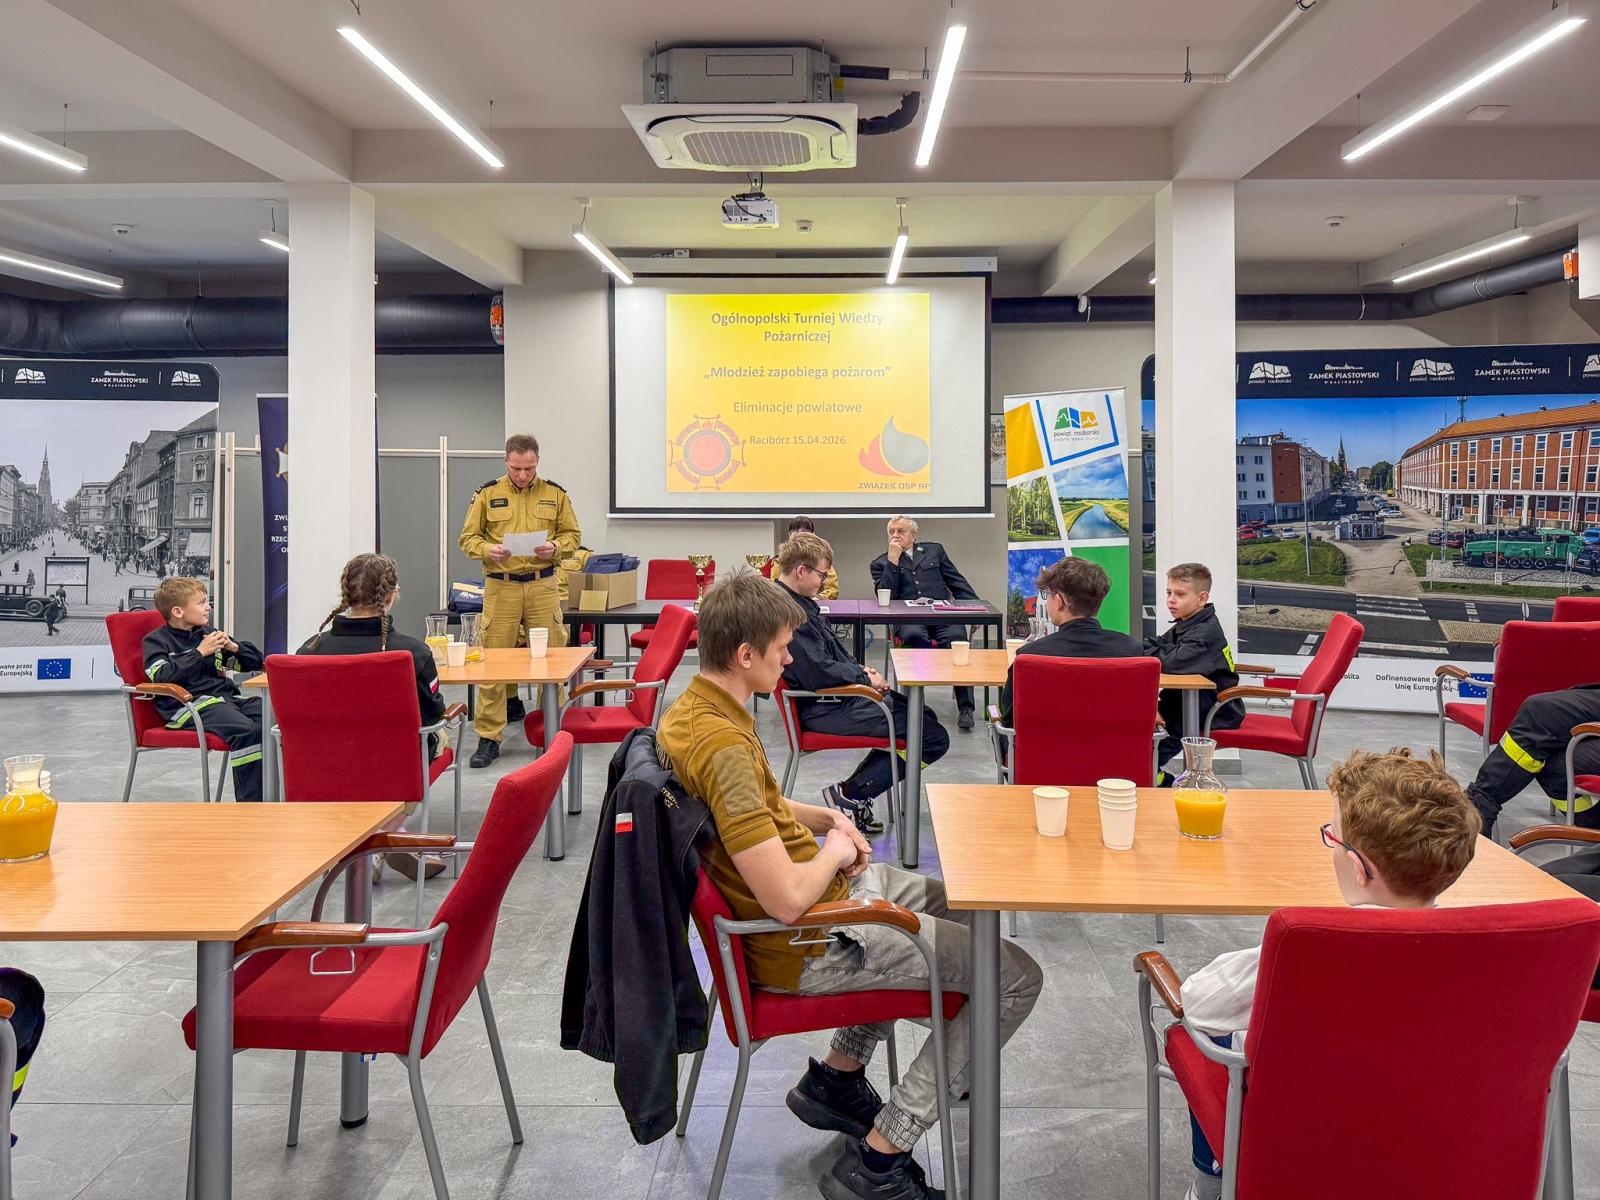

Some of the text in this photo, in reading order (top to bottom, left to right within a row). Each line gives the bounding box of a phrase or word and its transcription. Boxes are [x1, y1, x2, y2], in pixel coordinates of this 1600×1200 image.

[711, 312, 883, 326] Ogólnopolski Turniej Wiedzy
[764, 330, 831, 343] Pożarniczej
[704, 365, 764, 379] „Młodzież
[768, 365, 828, 379] zapobiega
[1308, 371, 1380, 380] ZAMEK PIASTOWSKI
[1503, 367, 1550, 375] PIASTOWSKI
[733, 401, 862, 414] Eliminacje powiatowe
[749, 435, 846, 445] Racibórz 15.04.2026
[858, 482, 930, 491] ZWIĄZEK OSP RP
[16, 663, 33, 671] przez
[1375, 673, 1430, 683] Dofinansowane
[1394, 683, 1411, 691] Unię
